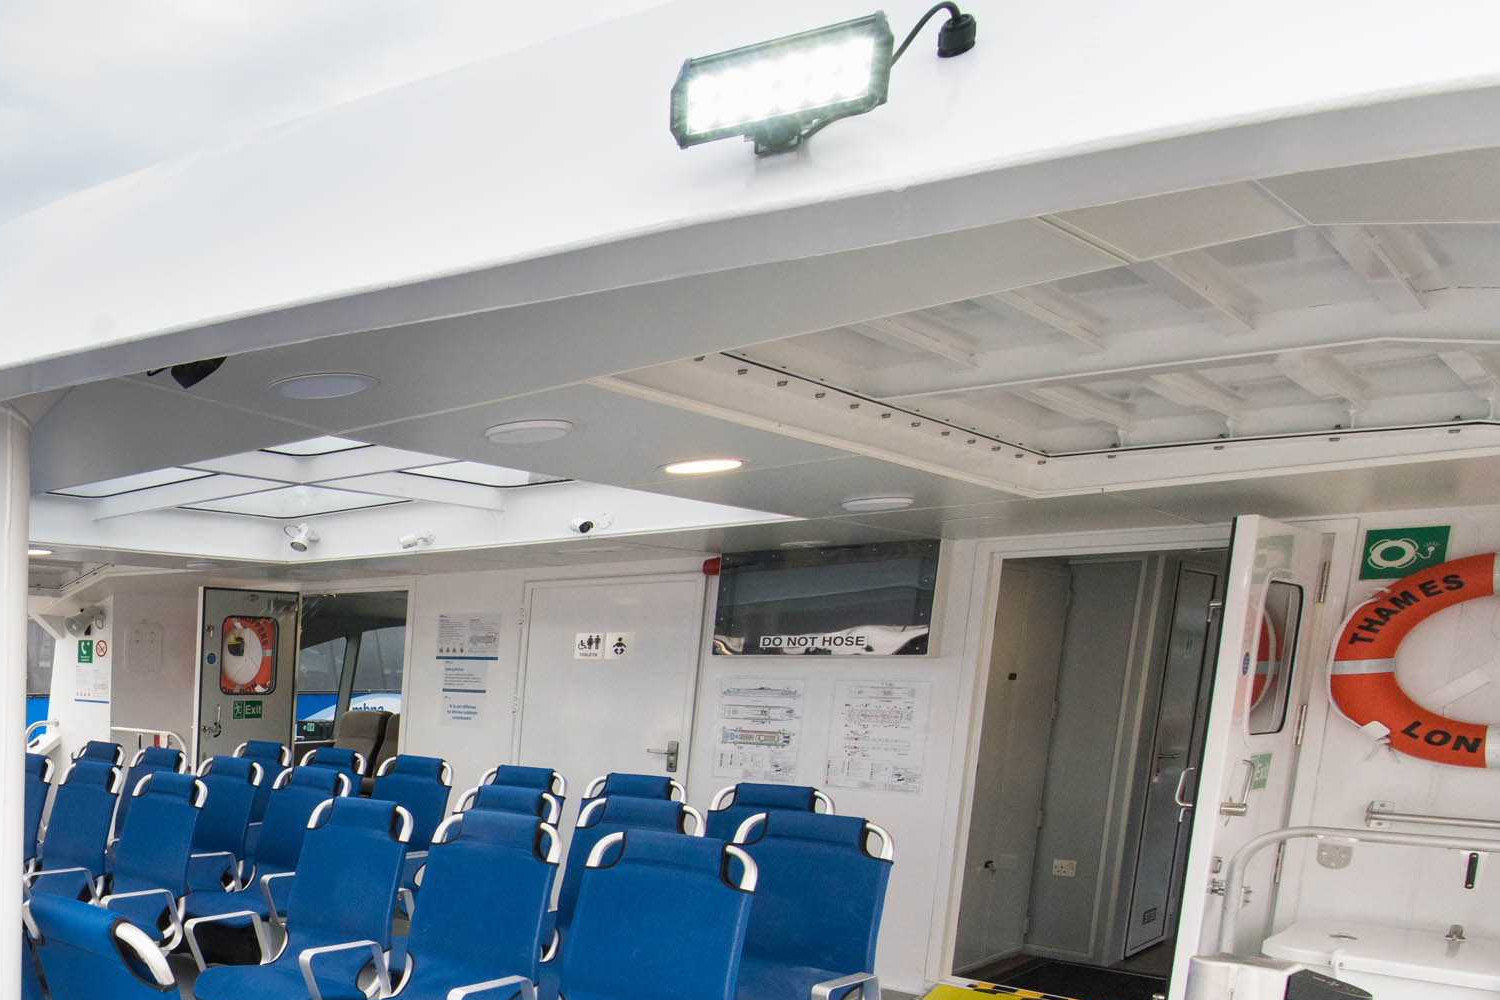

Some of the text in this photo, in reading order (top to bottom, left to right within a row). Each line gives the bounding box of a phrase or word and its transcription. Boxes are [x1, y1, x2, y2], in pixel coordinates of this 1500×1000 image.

[1348, 573, 1466, 646] THAMES
[761, 635, 866, 647] DO NOT HOSE
[245, 704, 262, 713] Exit
[1401, 721, 1483, 754] LON
